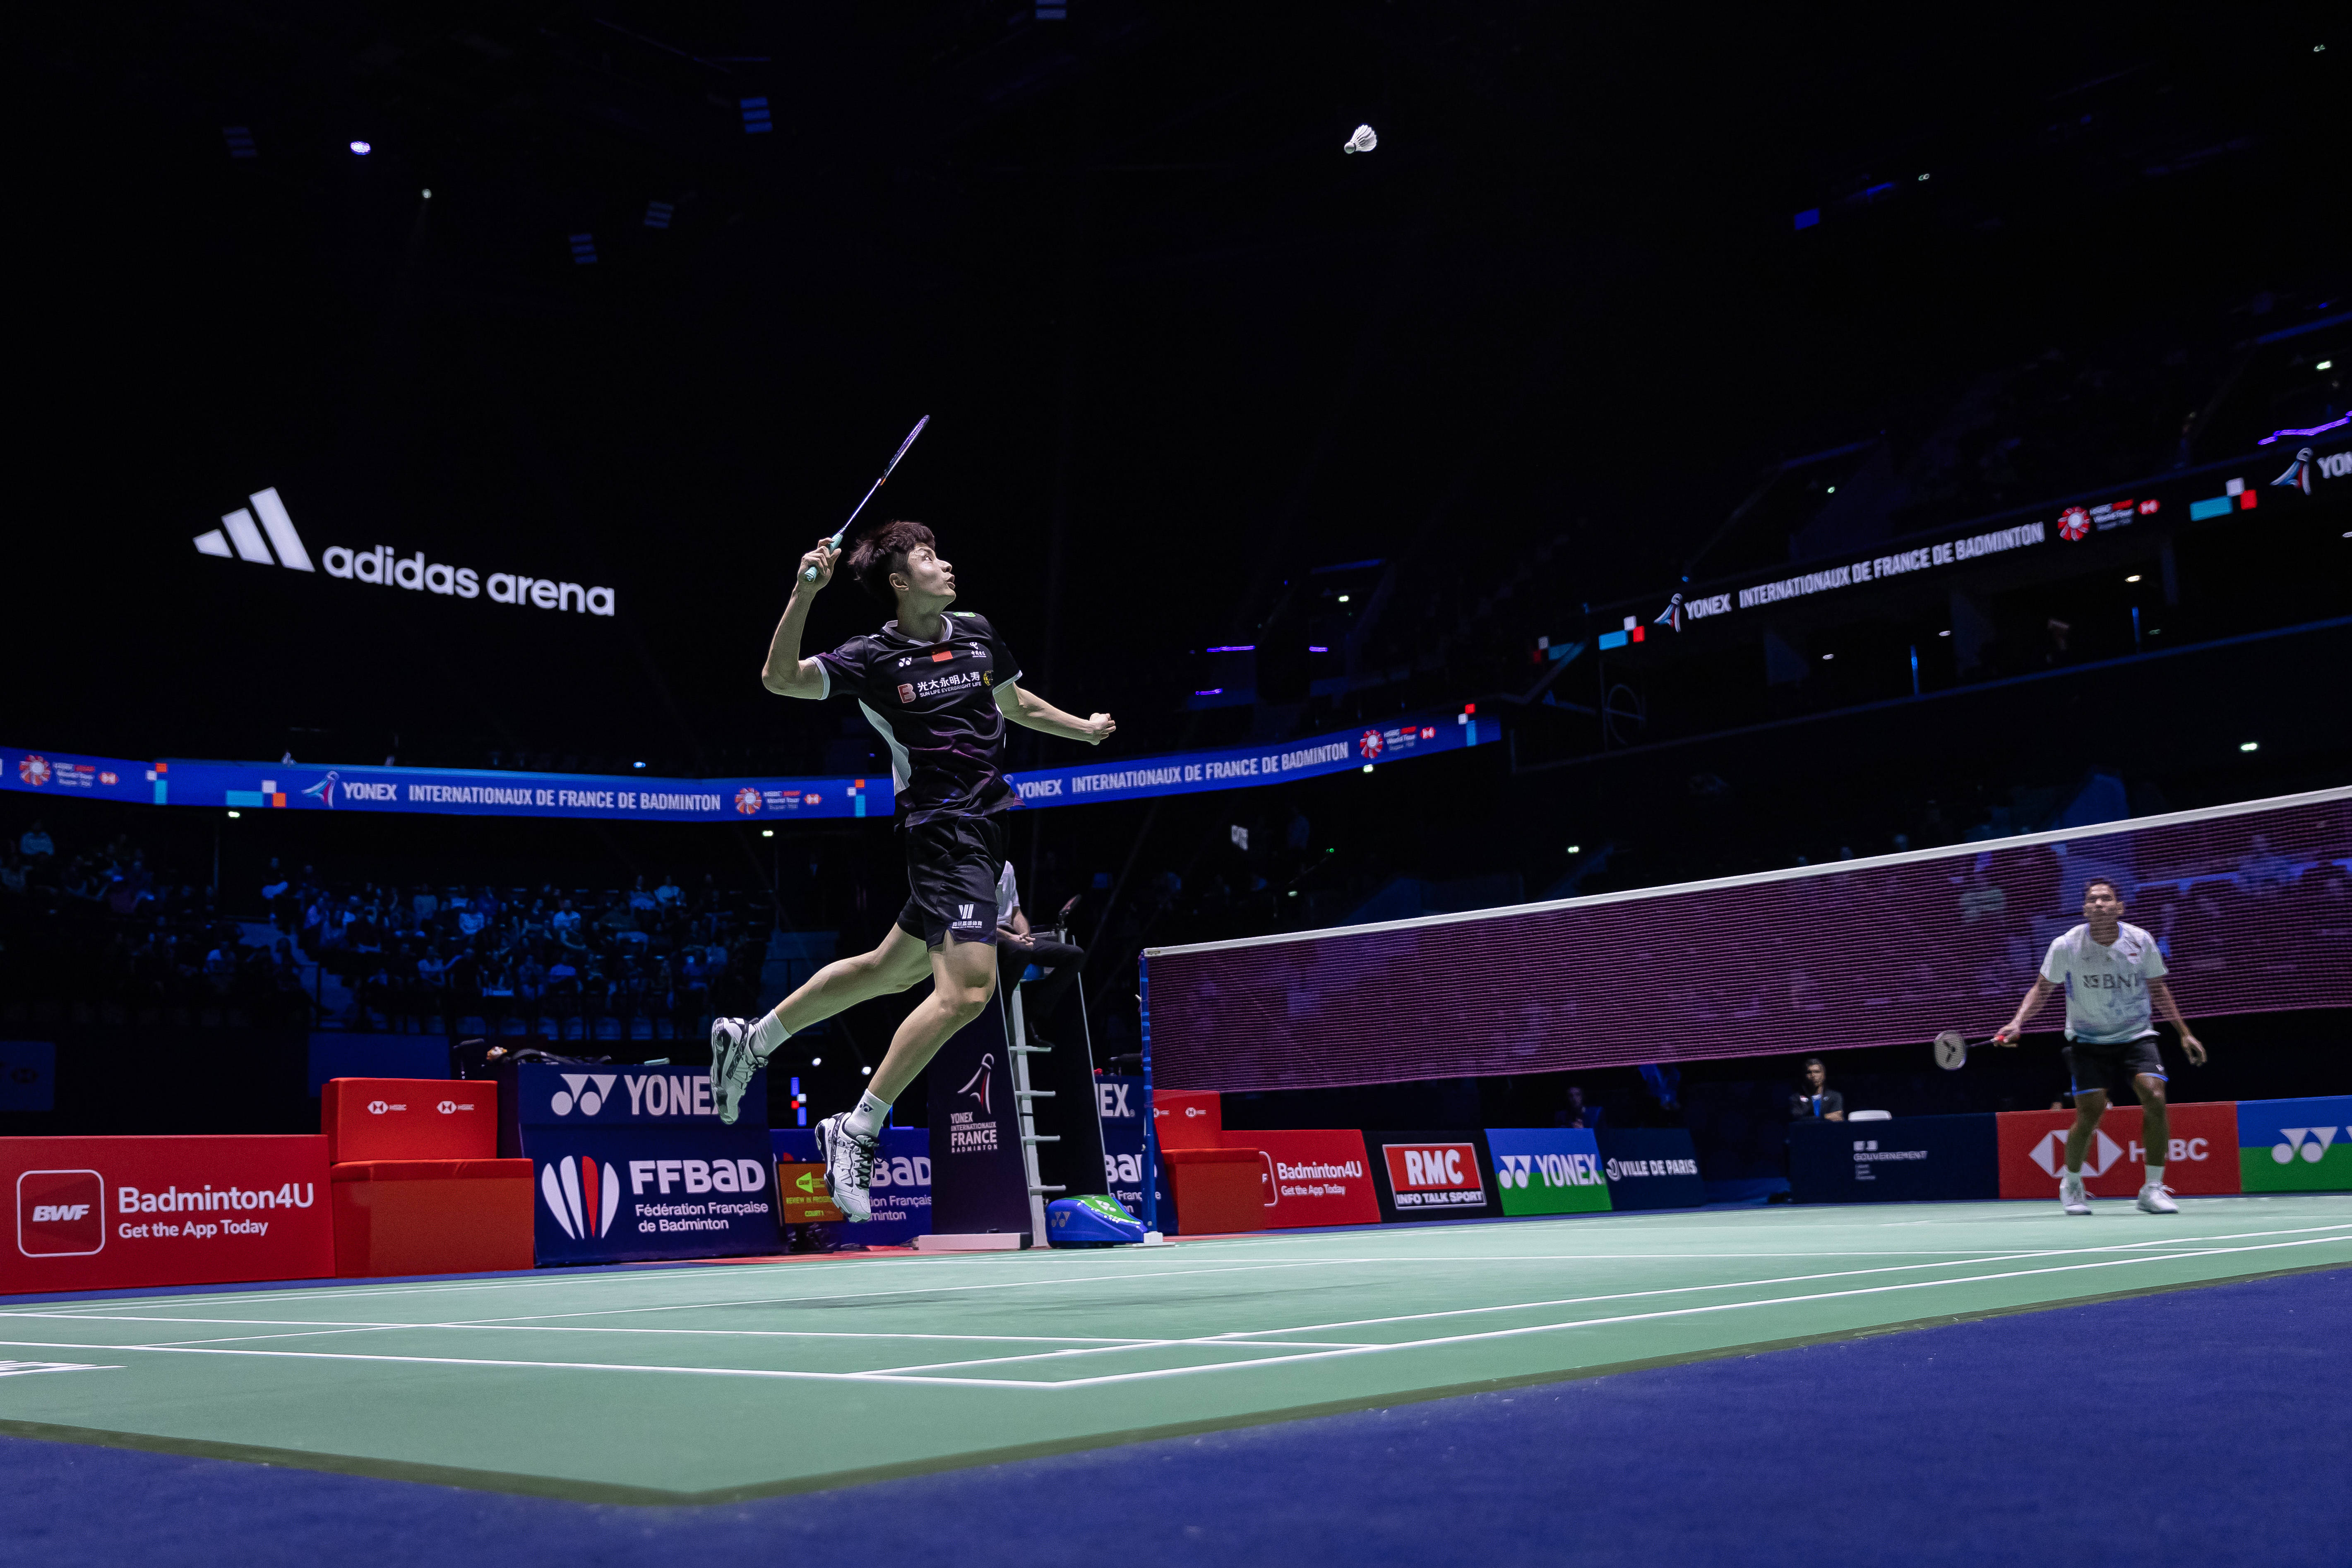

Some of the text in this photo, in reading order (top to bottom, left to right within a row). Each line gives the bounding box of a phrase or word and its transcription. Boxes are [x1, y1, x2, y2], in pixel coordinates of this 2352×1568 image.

[1684, 521, 2044, 620] YONEX INTERNATIONAUX DE FRANCE DE BADMINTON
[323, 545, 615, 616] adidas arena
[917, 672, 980, 692] 光大永明人寿
[942, 683, 971, 693] EVERBRIGHT
[1016, 742, 1349, 799] YONEX INTERNATIONAUX DE FRANCE DE BADMINTON
[342, 782, 721, 811] YONEX INTERNATIONAUX DE FRANCE DE BADMINTON
[2103, 973, 2139, 988] BNI
[623, 1075, 720, 1116] YONE
[950, 1112, 973, 1124] YONEX
[951, 1129, 997, 1146] FRANCE
[951, 1144, 998, 1153] BADMINTON
[2129, 1137, 2209, 1163] HBC
[870, 1157, 931, 1186] BaD
[1276, 1160, 1363, 1180] Badminton4U
[1404, 1149, 1464, 1186] RMC
[1619, 1158, 1698, 1177] VILLE DE PARIS
[118, 1183, 314, 1213] Badminton4U
[1281, 1185, 1295, 1196] Get
[1309, 1185, 1324, 1197] App
[1324, 1184, 1346, 1196] Today
[1397, 1191, 1484, 1205] INFO TALK SPORT
[33, 1204, 90, 1222] BWF
[635, 1201, 769, 1217] Fédération Française
[870, 1210, 906, 1221] minton
[118, 1219, 269, 1239] Get the App Today
[639, 1218, 729, 1233] de Badminton
